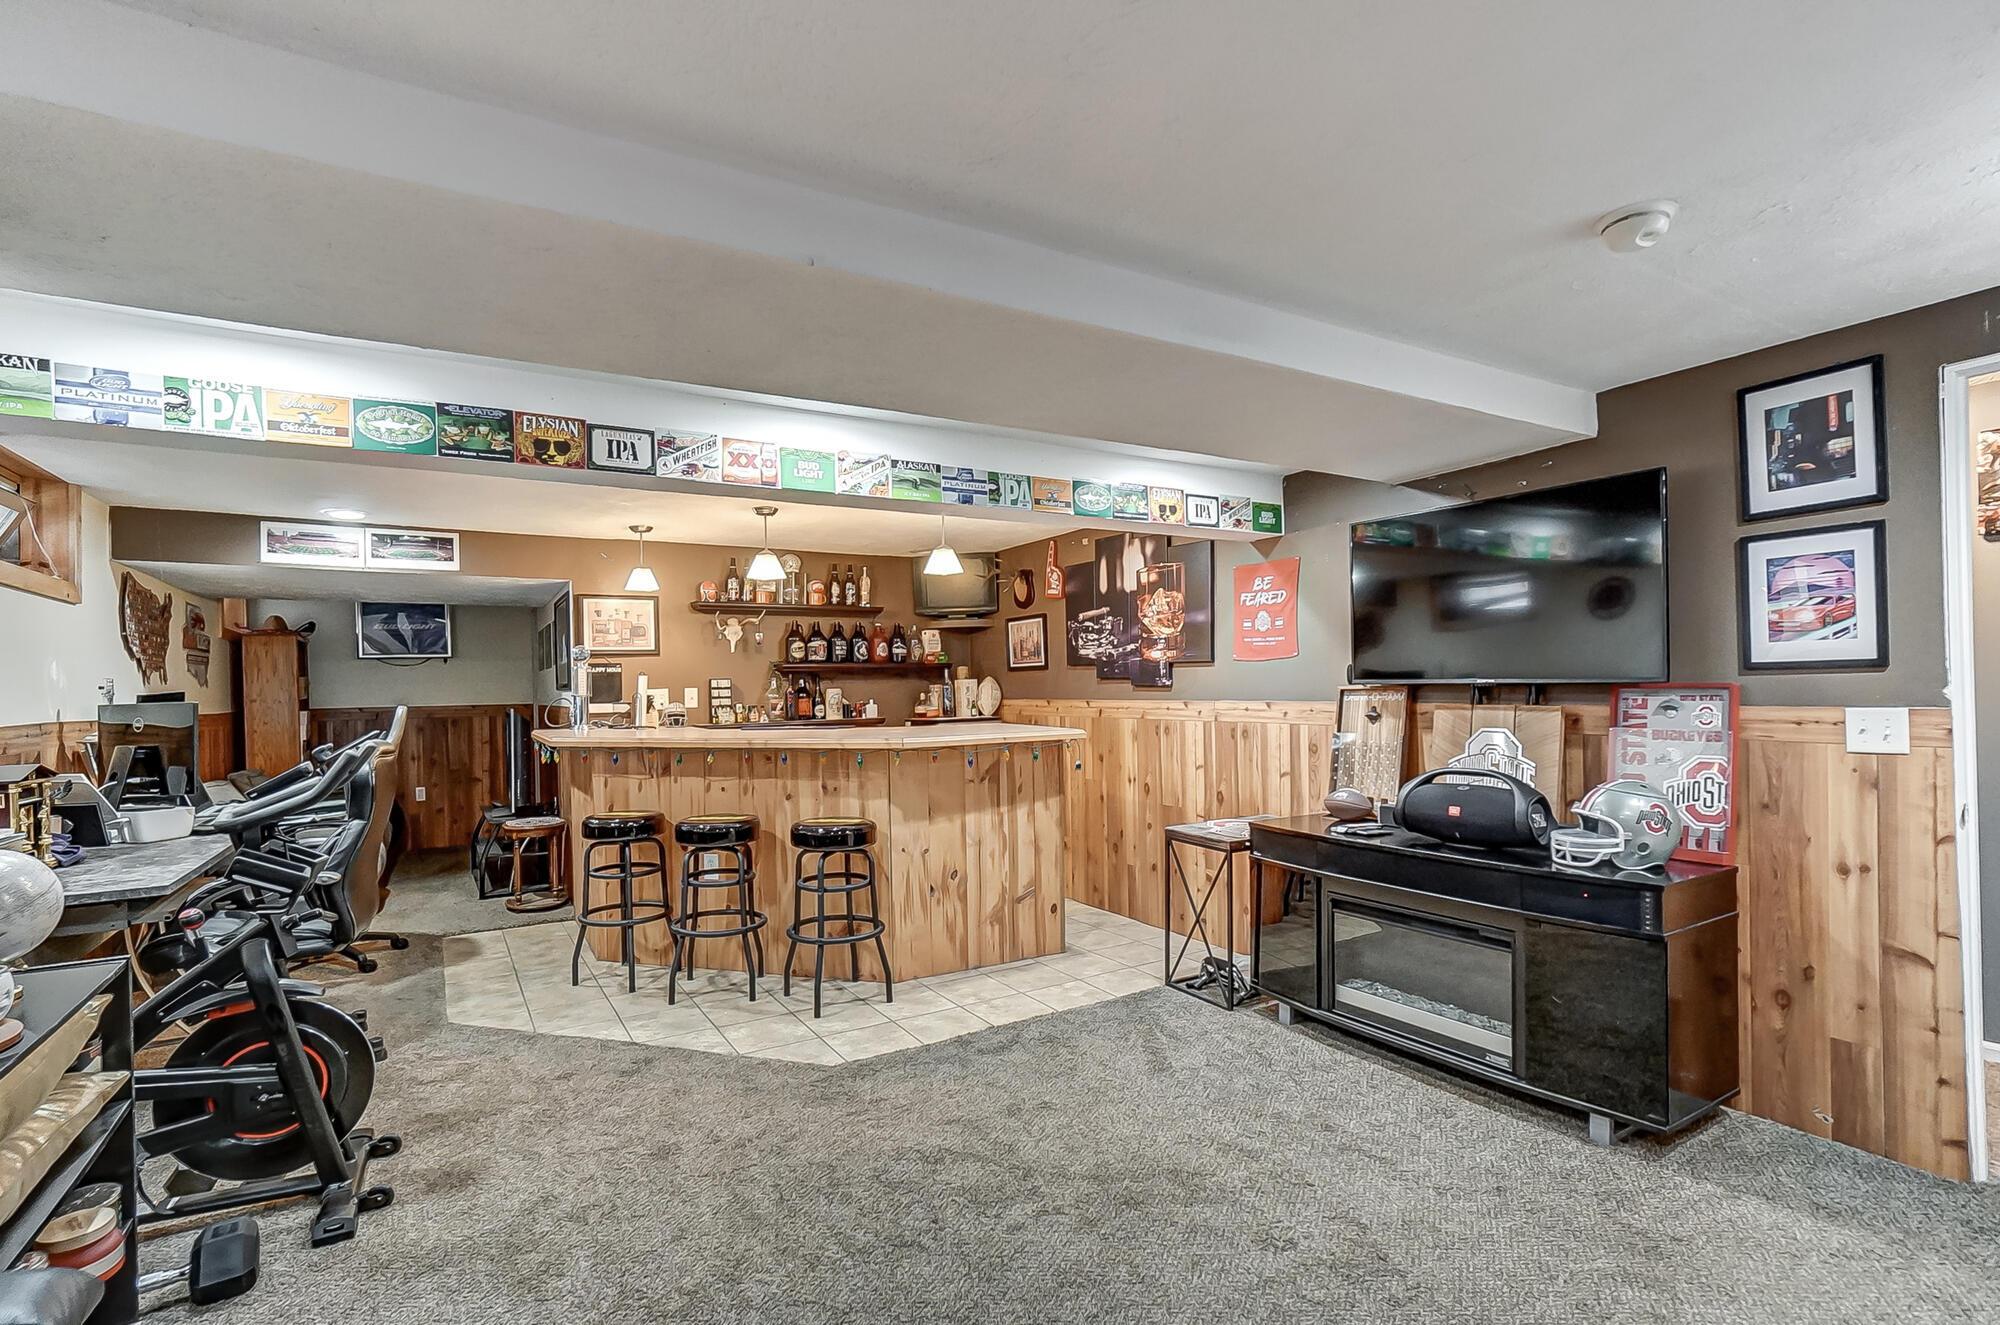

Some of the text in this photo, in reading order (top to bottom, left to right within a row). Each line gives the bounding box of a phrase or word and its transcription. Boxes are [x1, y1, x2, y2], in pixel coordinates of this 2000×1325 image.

[188, 379, 255, 394] GOOSE
[61, 387, 158, 406] PLATINUM
[190, 388, 264, 437] IPA
[447, 405, 504, 418] ELEVATOR
[523, 415, 579, 438] ELYSIAN
[606, 438, 640, 462] IPA
[672, 438, 717, 466] WHEATFISH
[727, 451, 759, 470] XX
[797, 460, 820, 470] BUD
[871, 460, 886, 474] IPA
[897, 460, 937, 476] ALASKAN
[793, 468, 824, 480] LIGHT
[943, 480, 986, 490] PLATINUM
[999, 479, 1032, 508] IPA
[1194, 503, 1212, 519] IPA
[1252, 576, 1275, 591] BE
[1240, 590, 1287, 607] FEARED
[1651, 728, 1723, 743] BUCKEYES
